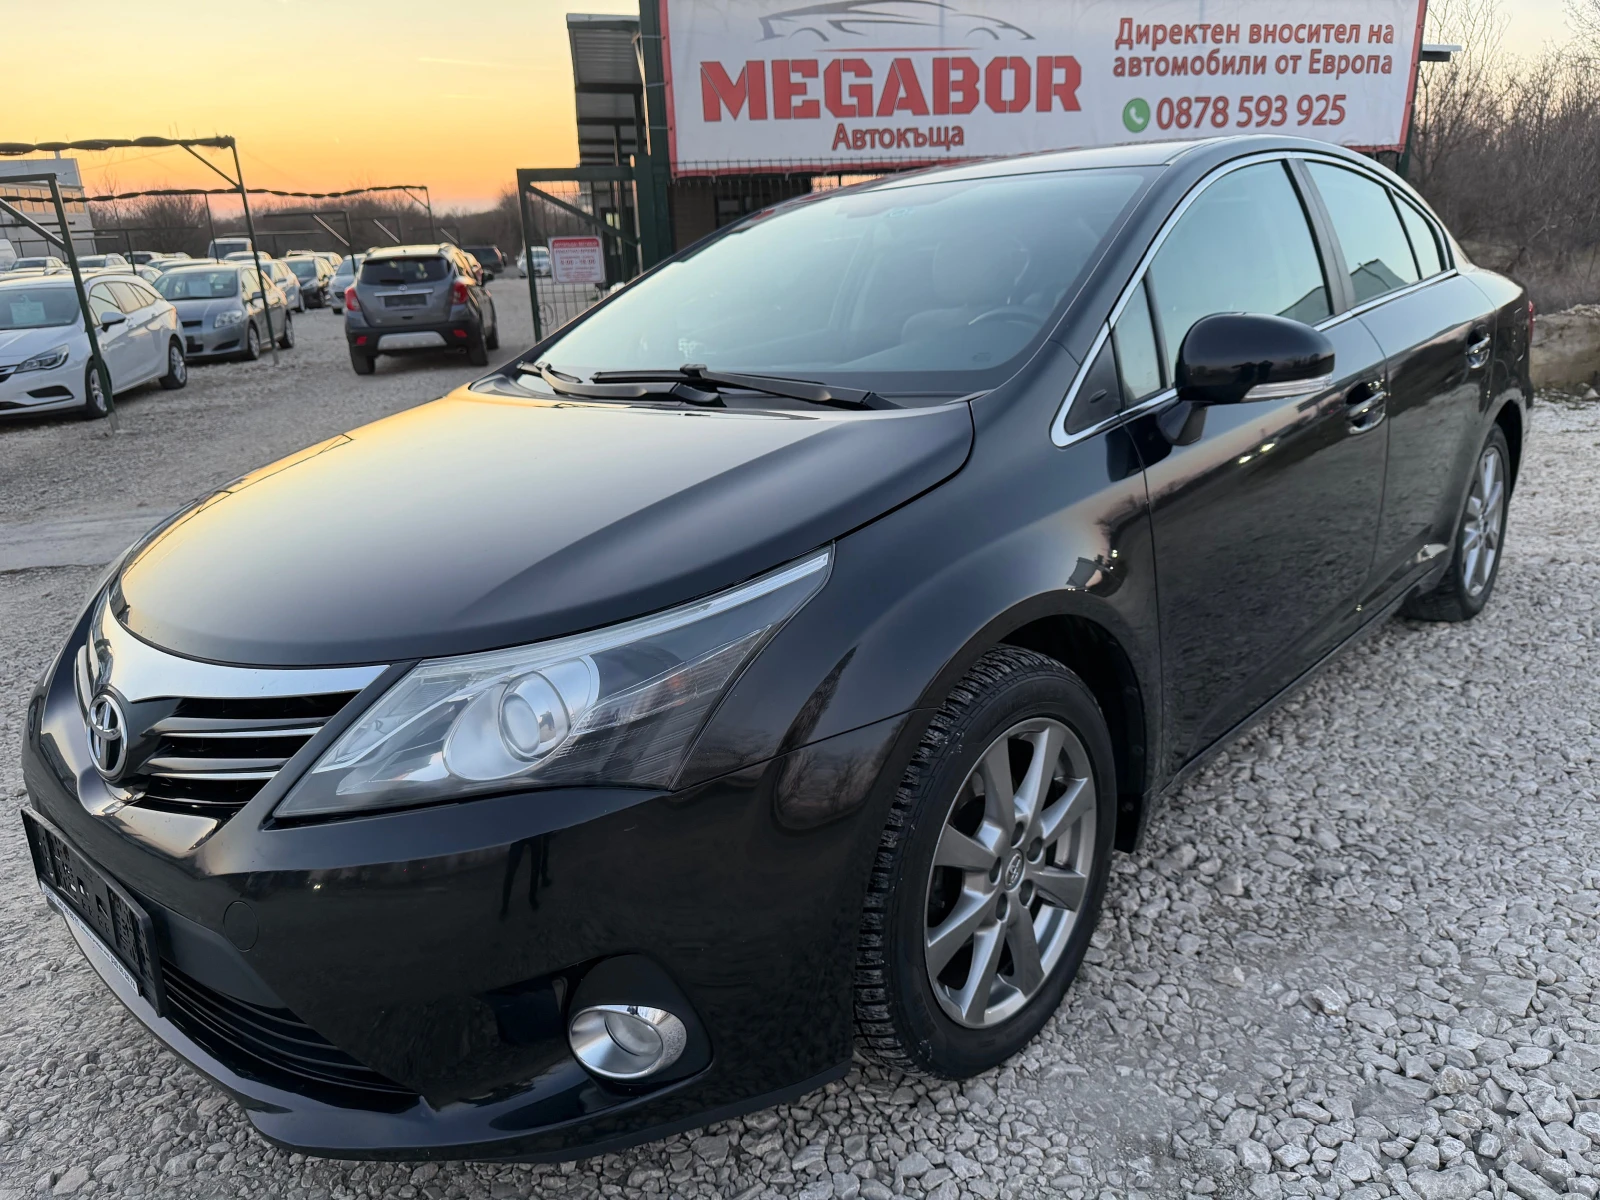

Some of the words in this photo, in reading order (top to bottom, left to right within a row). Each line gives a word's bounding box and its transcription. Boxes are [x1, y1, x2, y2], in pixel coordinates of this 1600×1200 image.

[1114, 17, 1241, 51] Директен
[1249, 23, 1360, 45] вносител
[1367, 23, 1394, 45] на
[1113, 50, 1267, 78] автомобили
[1275, 51, 1302, 76] от
[1308, 49, 1393, 80] Европа
[700, 55, 1082, 122] MEGABOR
[1156, 96, 1229, 130] 0878
[1236, 94, 1288, 128] 593
[1296, 93, 1347, 127] 925
[832, 122, 965, 151] Автокъща
